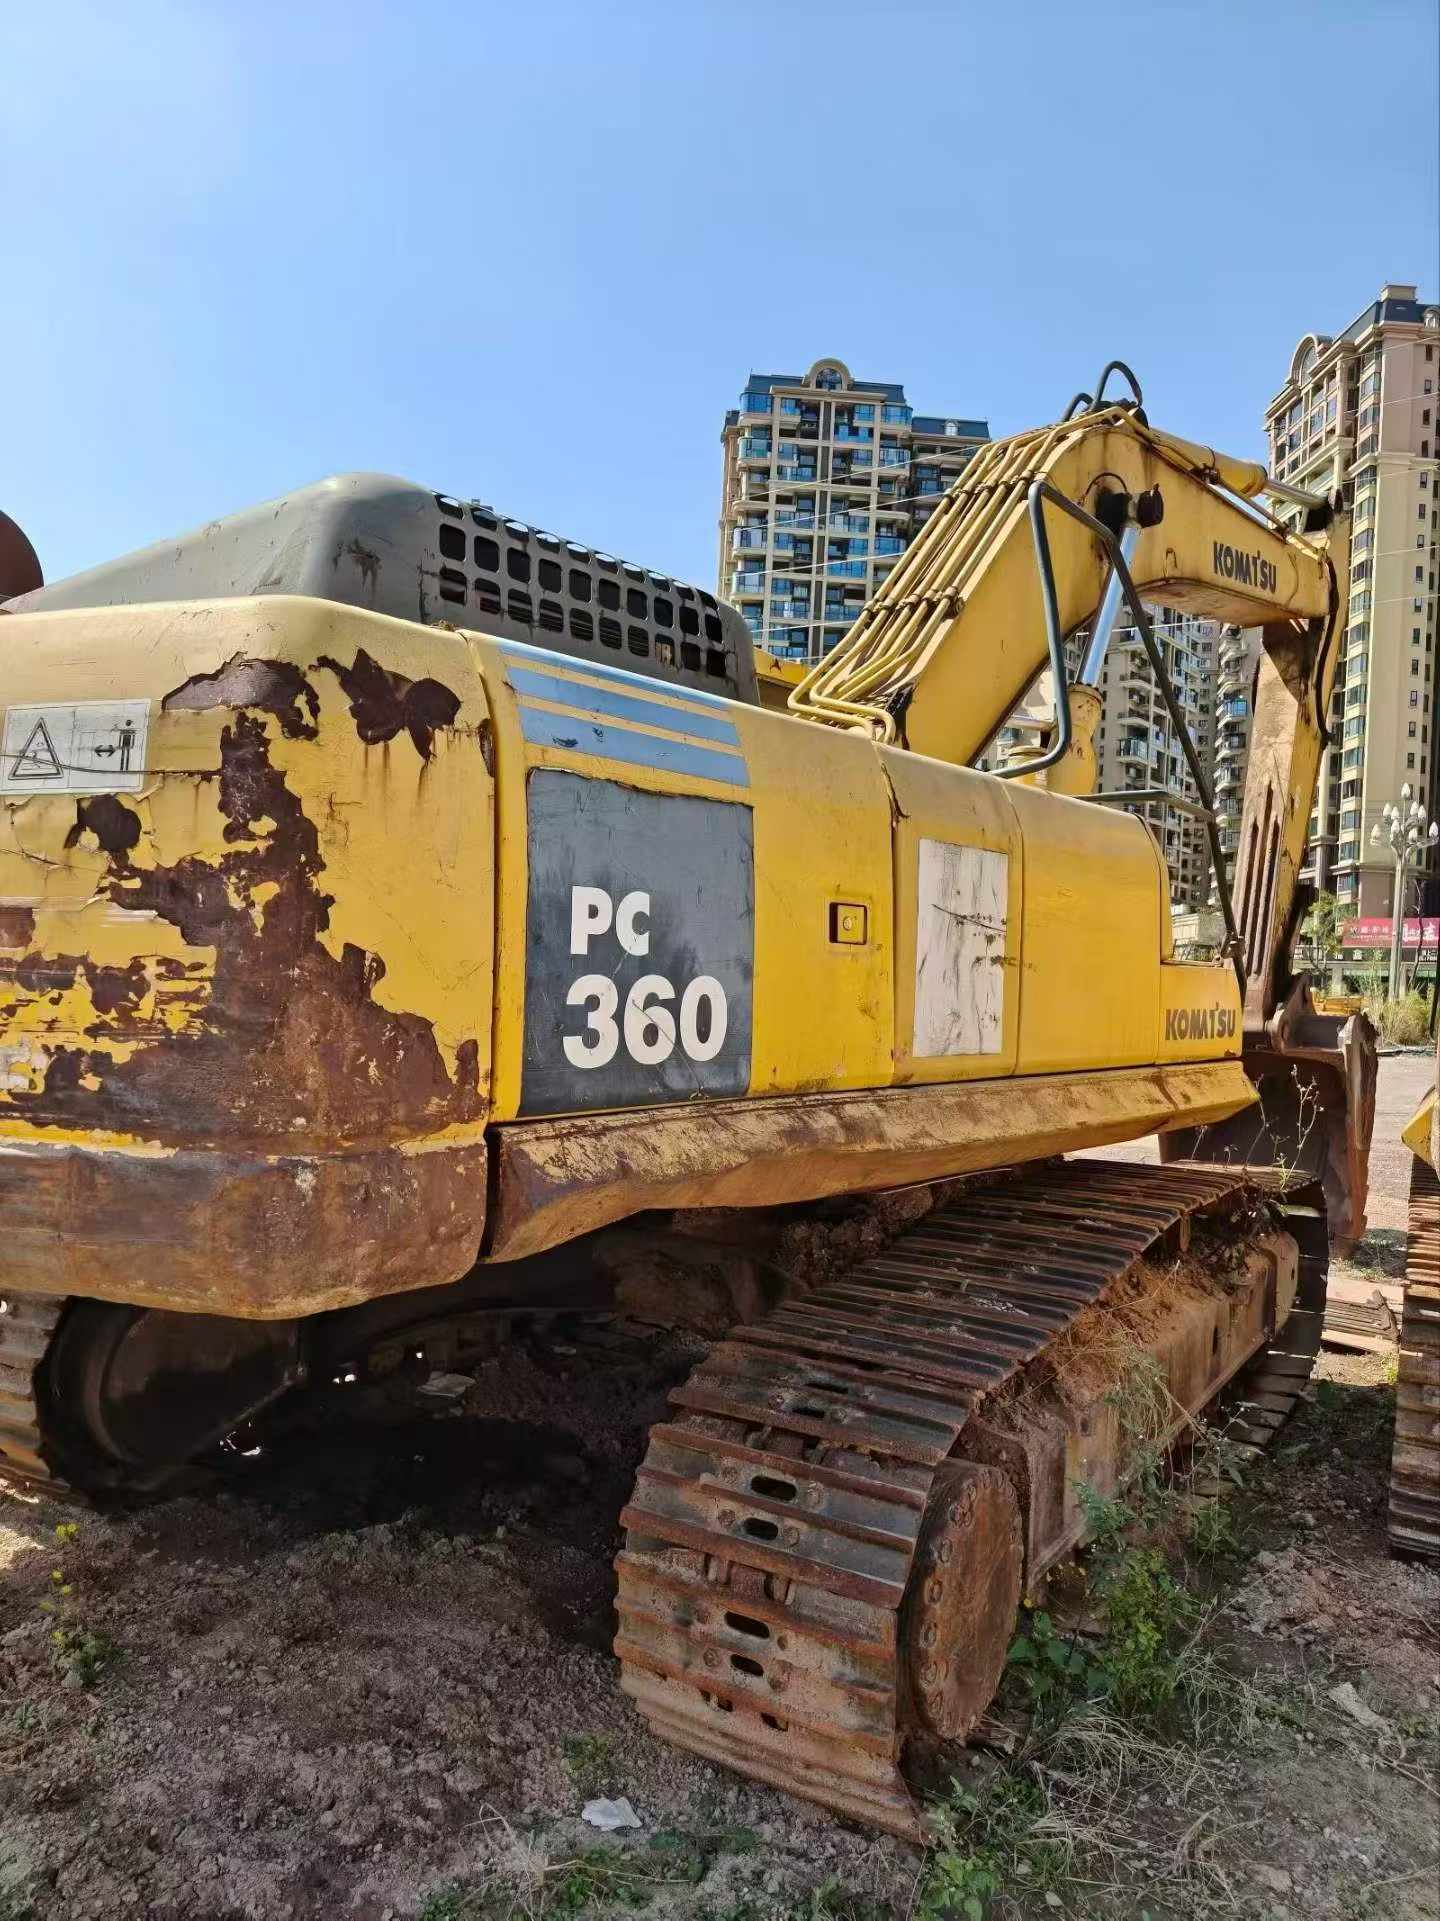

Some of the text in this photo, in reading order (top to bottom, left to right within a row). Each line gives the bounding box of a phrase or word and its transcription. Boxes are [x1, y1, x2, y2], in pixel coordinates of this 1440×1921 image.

[1213, 540, 1277, 594] KOMATSU
[570, 886, 650, 956] PC
[563, 974, 728, 1068] 360
[1165, 1001, 1236, 1040] KOMATSU
